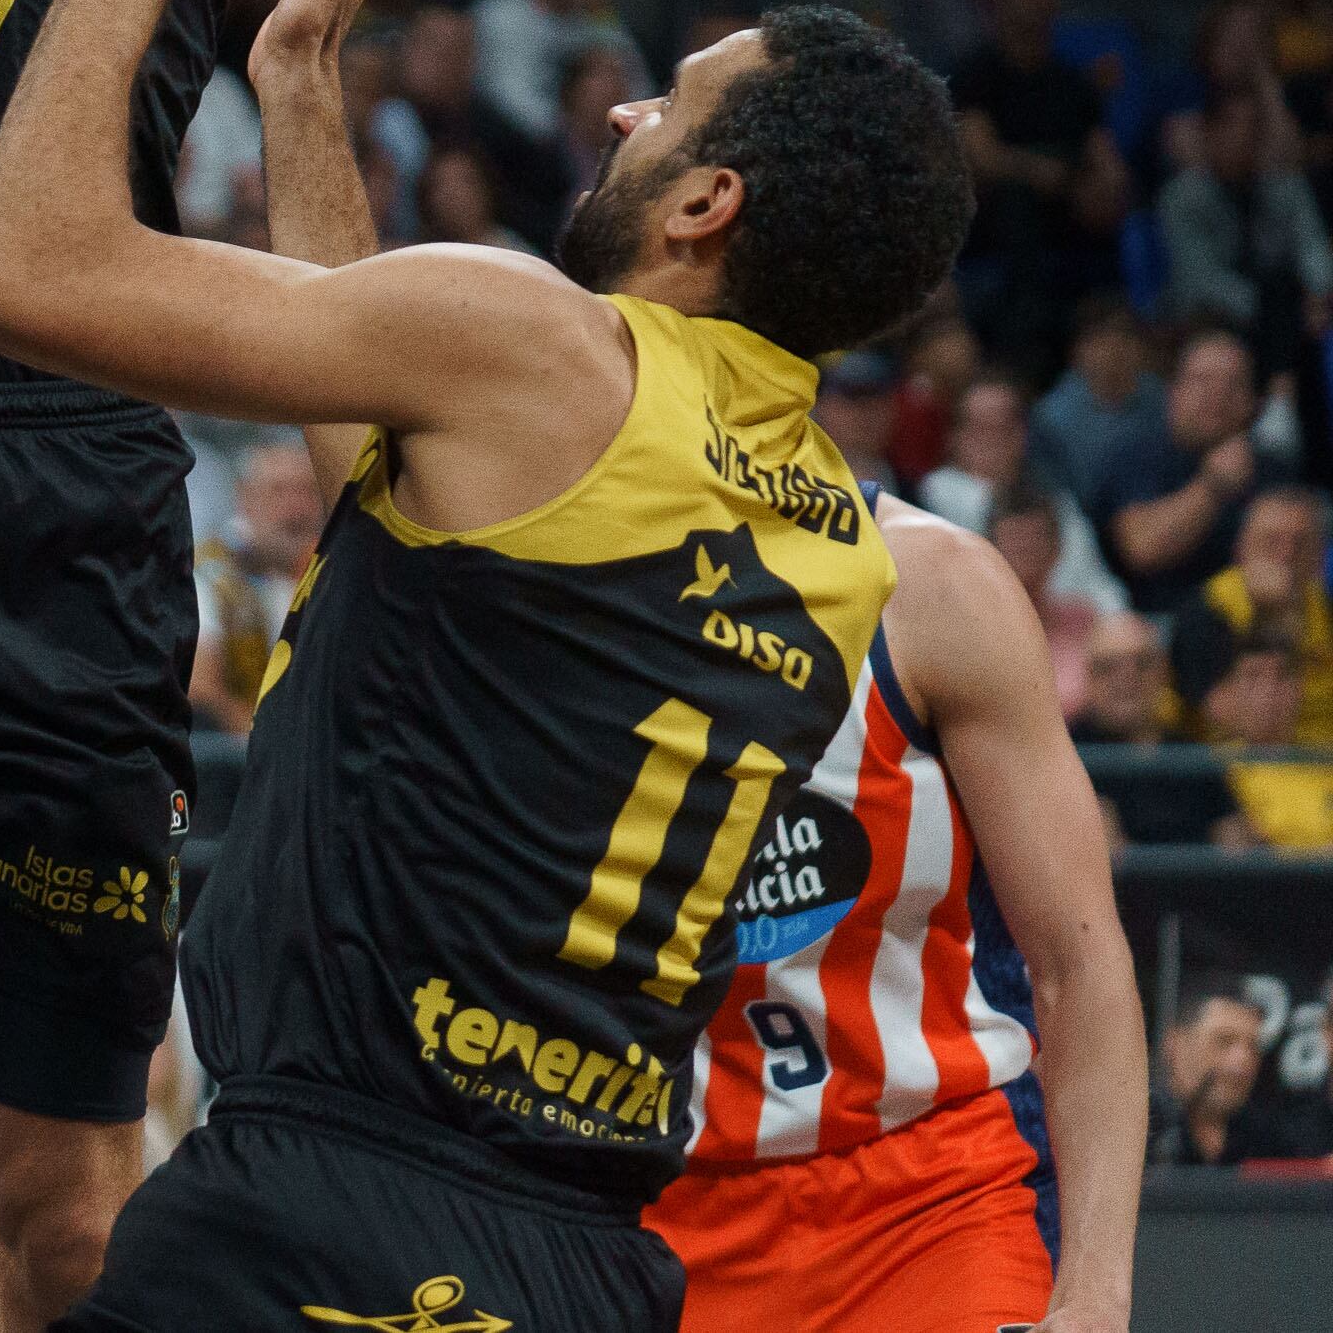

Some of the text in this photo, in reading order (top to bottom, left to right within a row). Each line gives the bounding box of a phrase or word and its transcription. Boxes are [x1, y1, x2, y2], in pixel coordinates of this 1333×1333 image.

[24, 843, 95, 890] Islas
[556, 696, 788, 1007] 11
[743, 999, 833, 1093] 9
